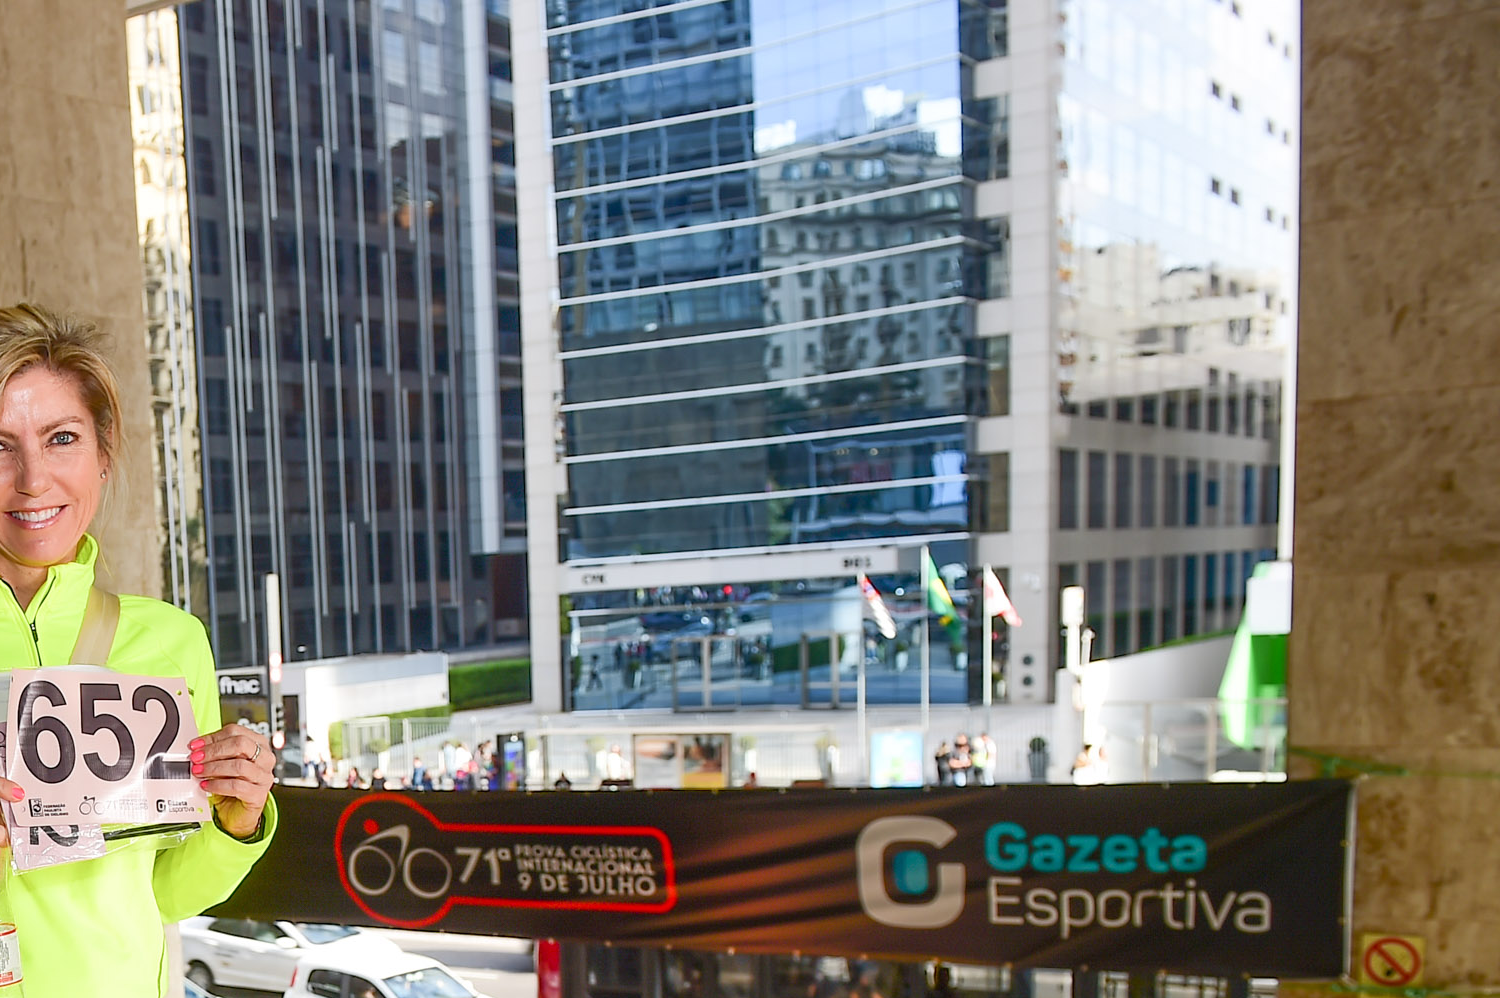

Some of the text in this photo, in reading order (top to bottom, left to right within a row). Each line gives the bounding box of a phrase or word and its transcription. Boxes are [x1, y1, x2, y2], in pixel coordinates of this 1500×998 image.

[220, 676, 260, 695] fnac
[17, 680, 191, 784] 652
[514, 843, 654, 860] PROVA CICLÍSTICA
[984, 821, 1207, 873] Gazeta
[517, 858, 656, 875] INTERNACIONAL
[518, 872, 657, 896] 9 DE JULHO
[988, 878, 1272, 940] Esportiva
